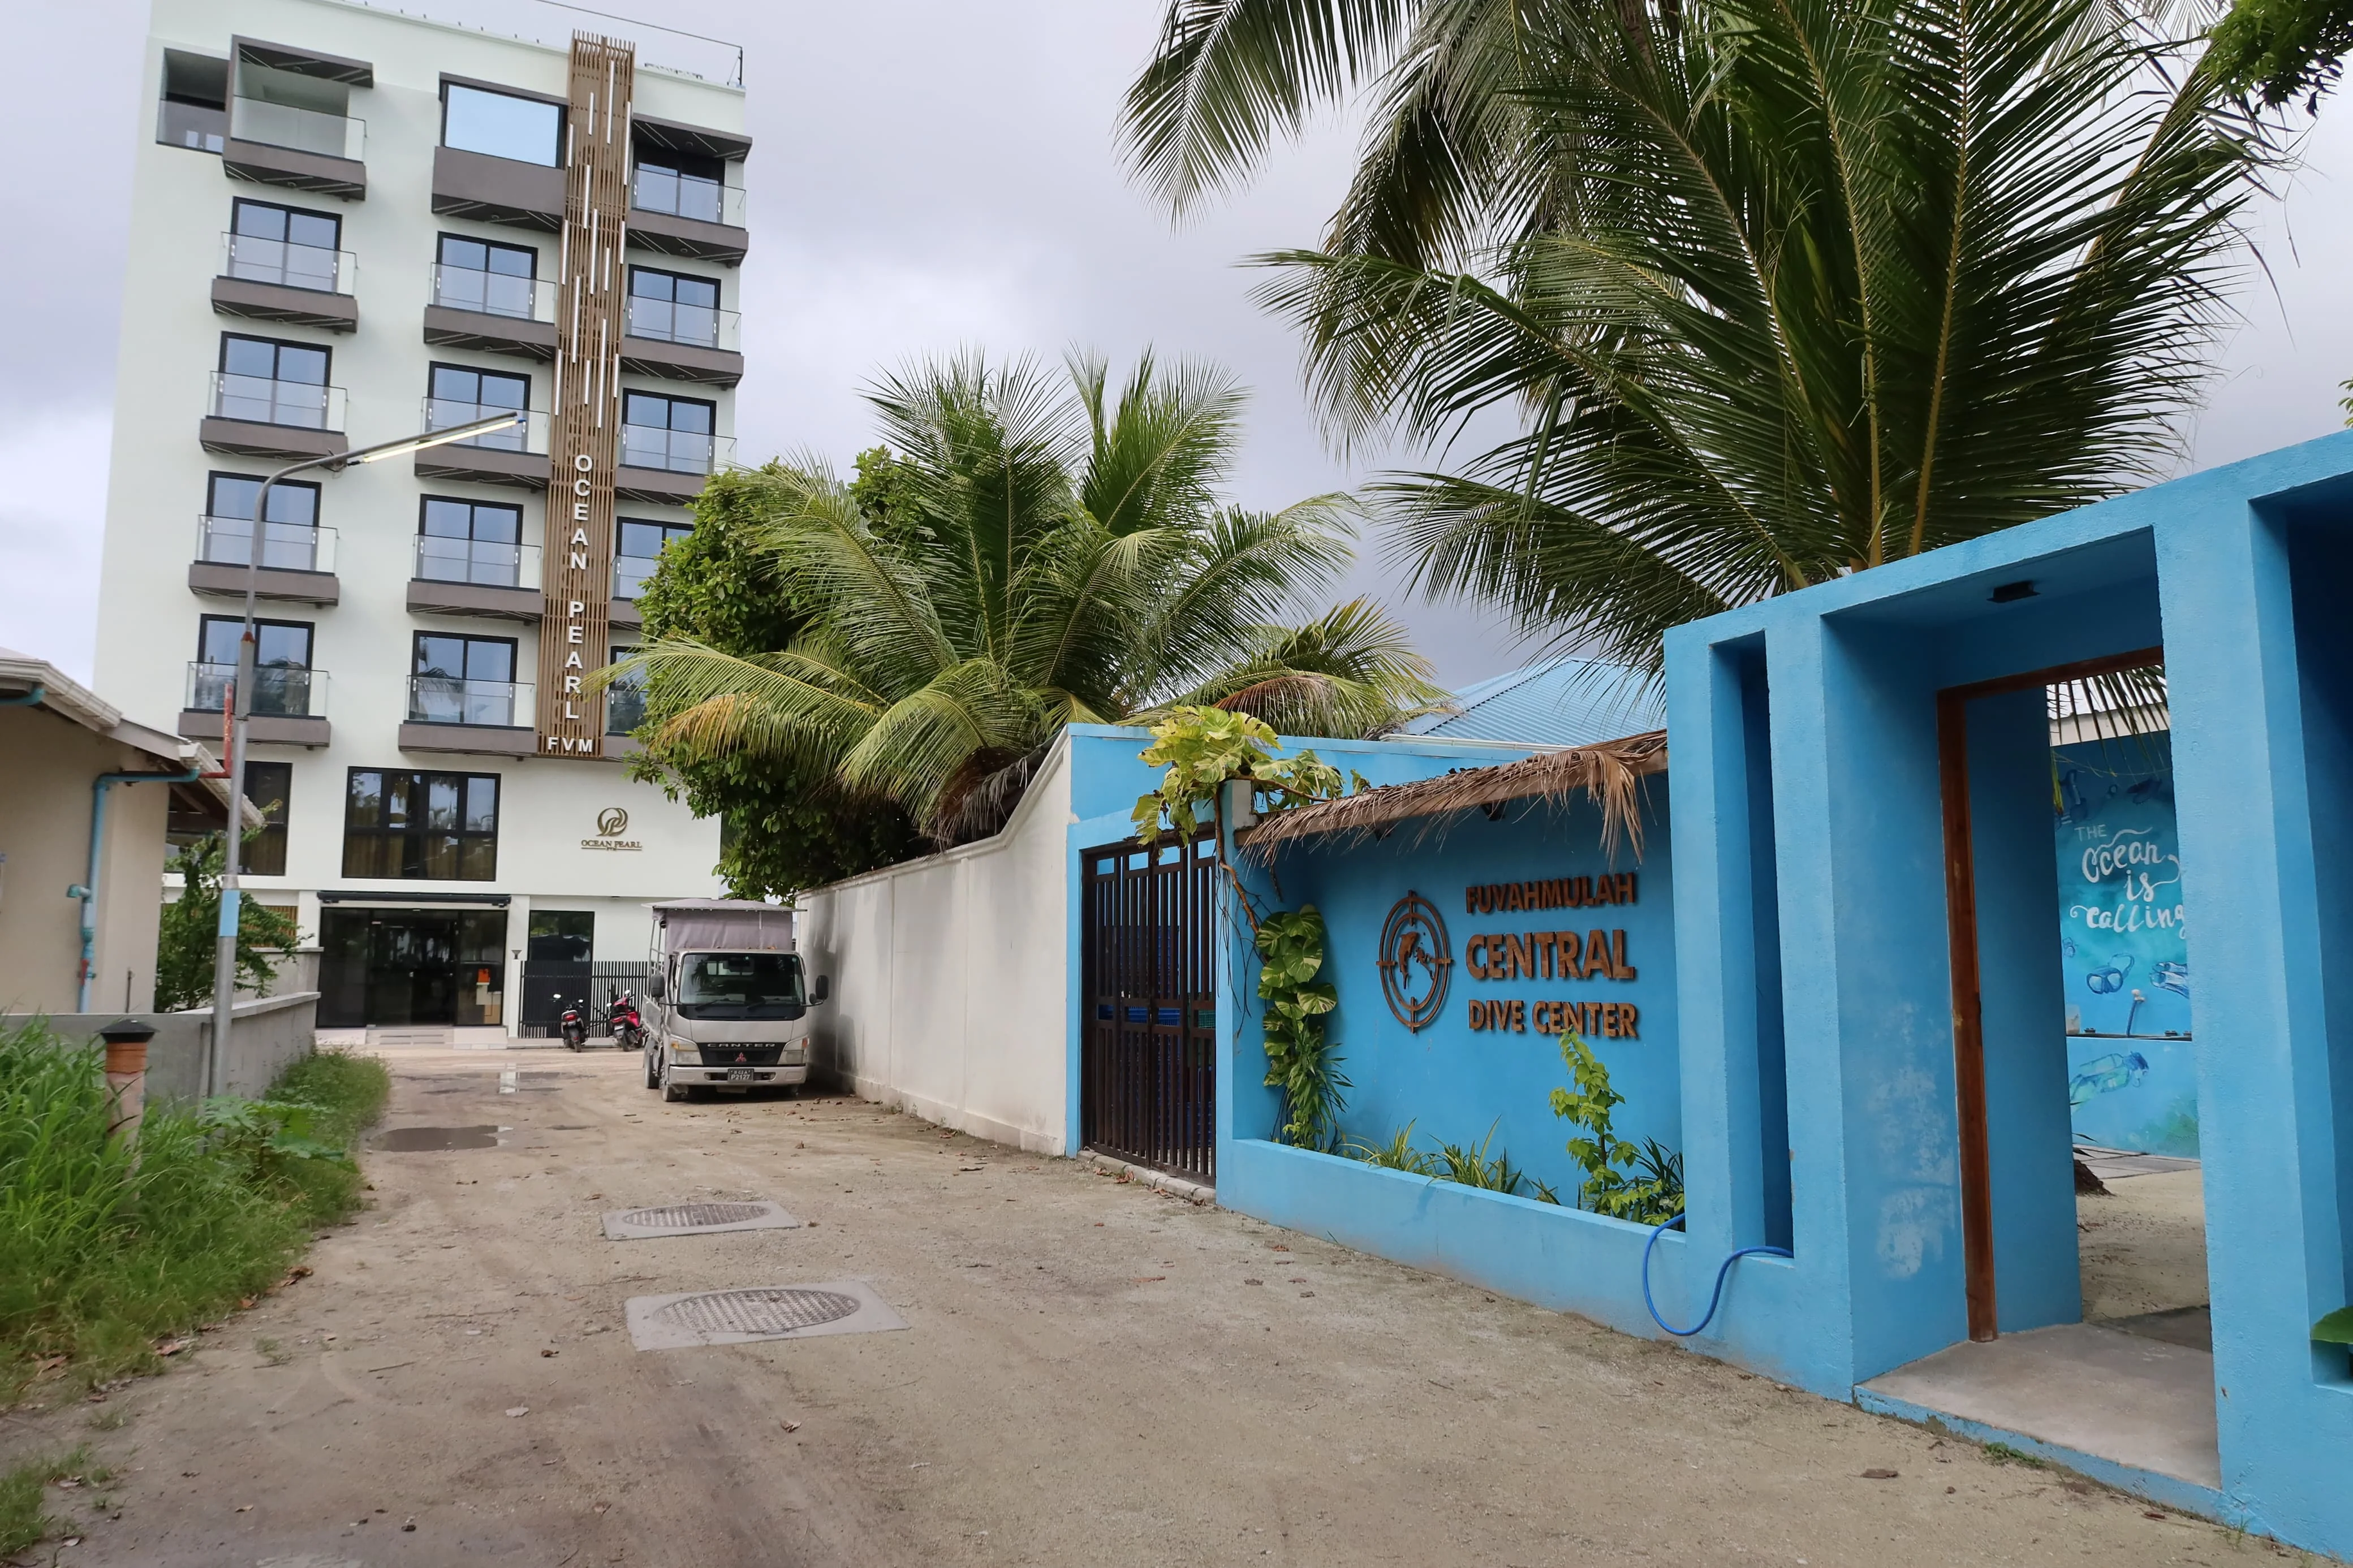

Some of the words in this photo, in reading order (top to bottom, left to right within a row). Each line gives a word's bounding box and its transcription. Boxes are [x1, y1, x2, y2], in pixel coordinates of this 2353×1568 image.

[571, 454, 593, 570] OCEAN
[565, 601, 584, 719] PEARL
[548, 736, 593, 753] FVM
[2074, 824, 2107, 841] THE
[1466, 872, 1635, 914] FUVAHMULAH
[1466, 929, 1635, 979] CENTRAL
[1468, 1000, 1524, 1031] DIVE
[1532, 1000, 1638, 1037] CENTER
